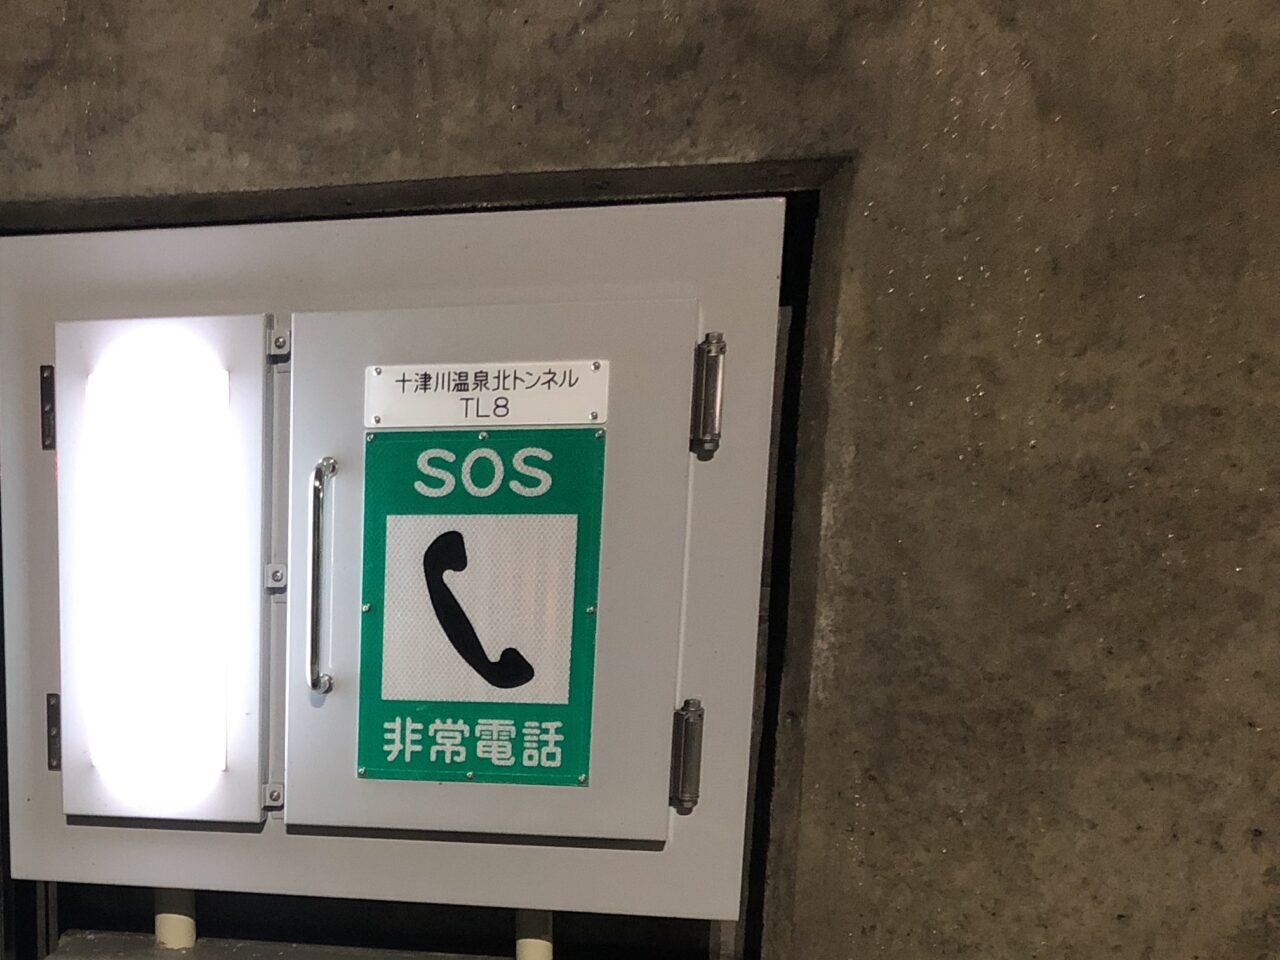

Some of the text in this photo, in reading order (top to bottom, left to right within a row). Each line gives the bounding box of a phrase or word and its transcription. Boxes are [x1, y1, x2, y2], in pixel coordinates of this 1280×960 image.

[394, 366, 580, 394] 十津川温泉北トンネル
[459, 396, 510, 419] TL8
[413, 447, 554, 498] SOS
[382, 716, 565, 768] 非常電話
